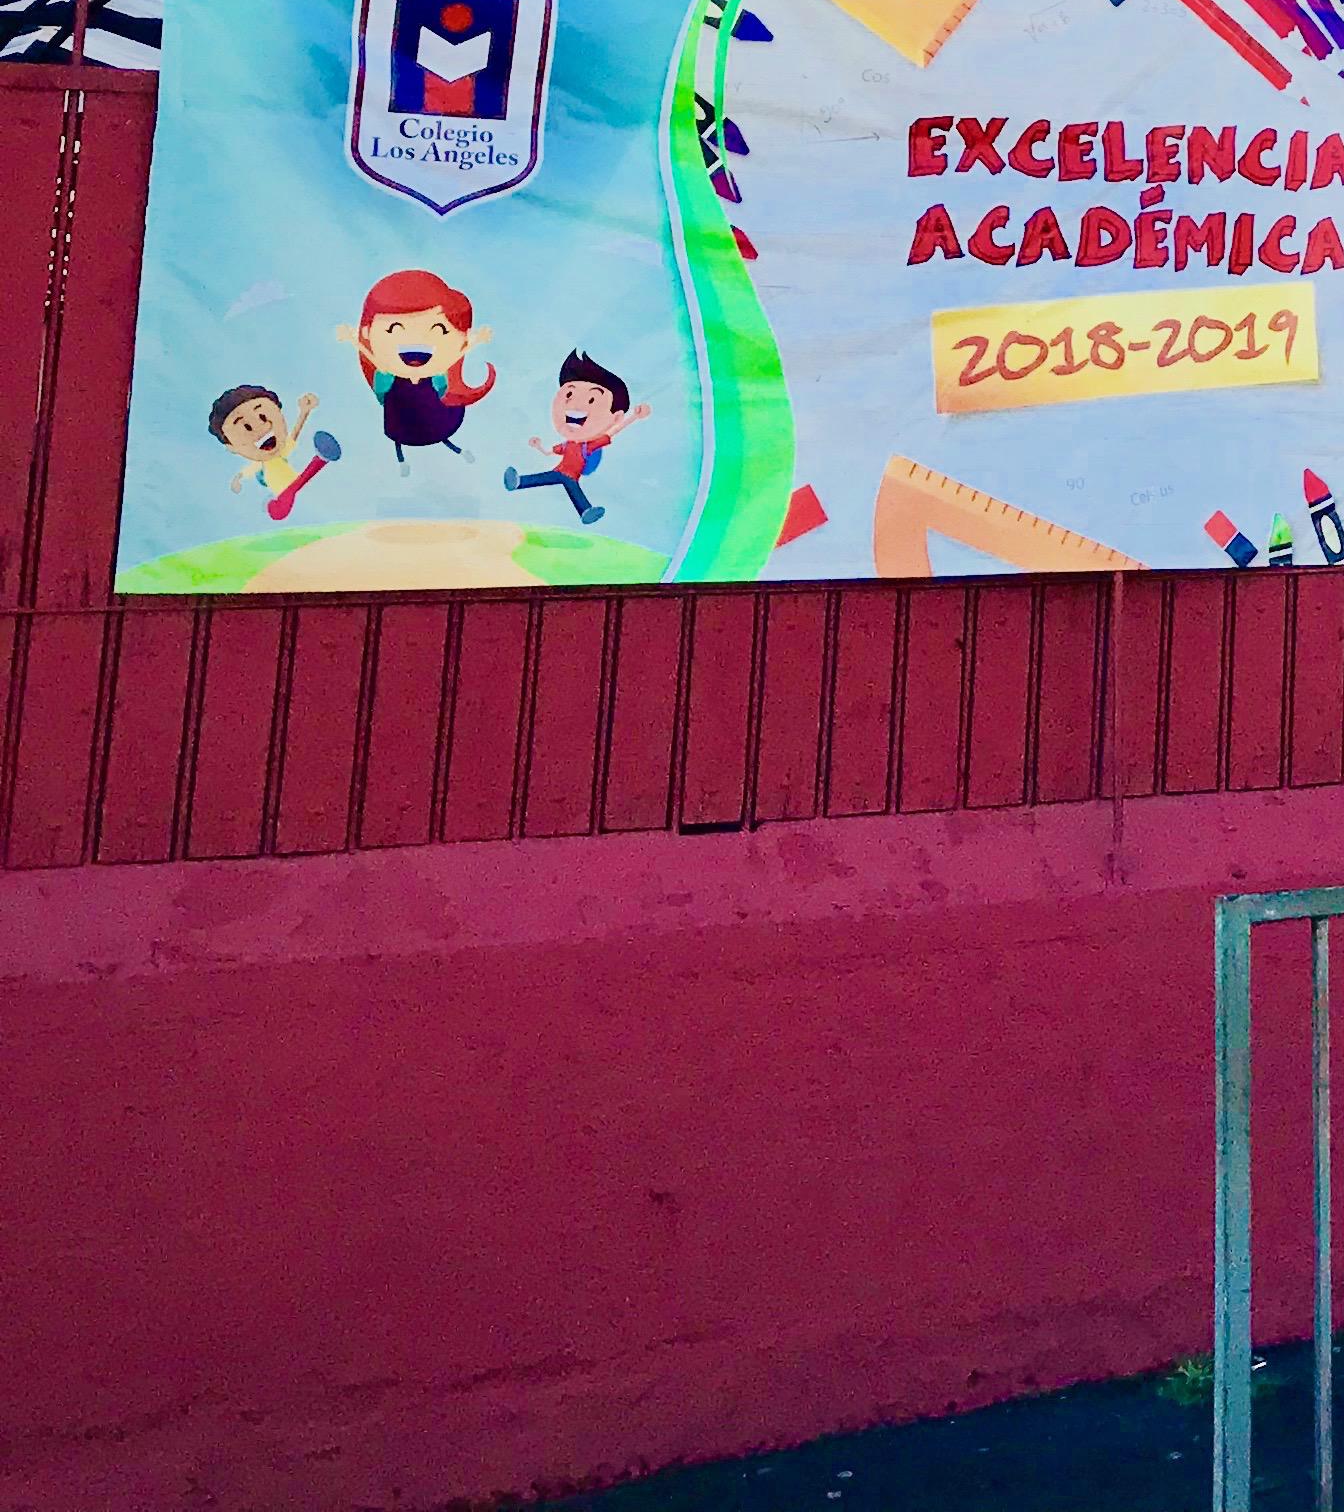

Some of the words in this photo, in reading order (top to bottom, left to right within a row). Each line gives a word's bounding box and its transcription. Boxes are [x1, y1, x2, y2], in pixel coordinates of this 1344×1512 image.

[398, 118, 494, 150] Colegio
[369, 136, 415, 162] Los
[420, 140, 520, 171] Angeles
[952, 308, 1299, 387] 2018-2019
